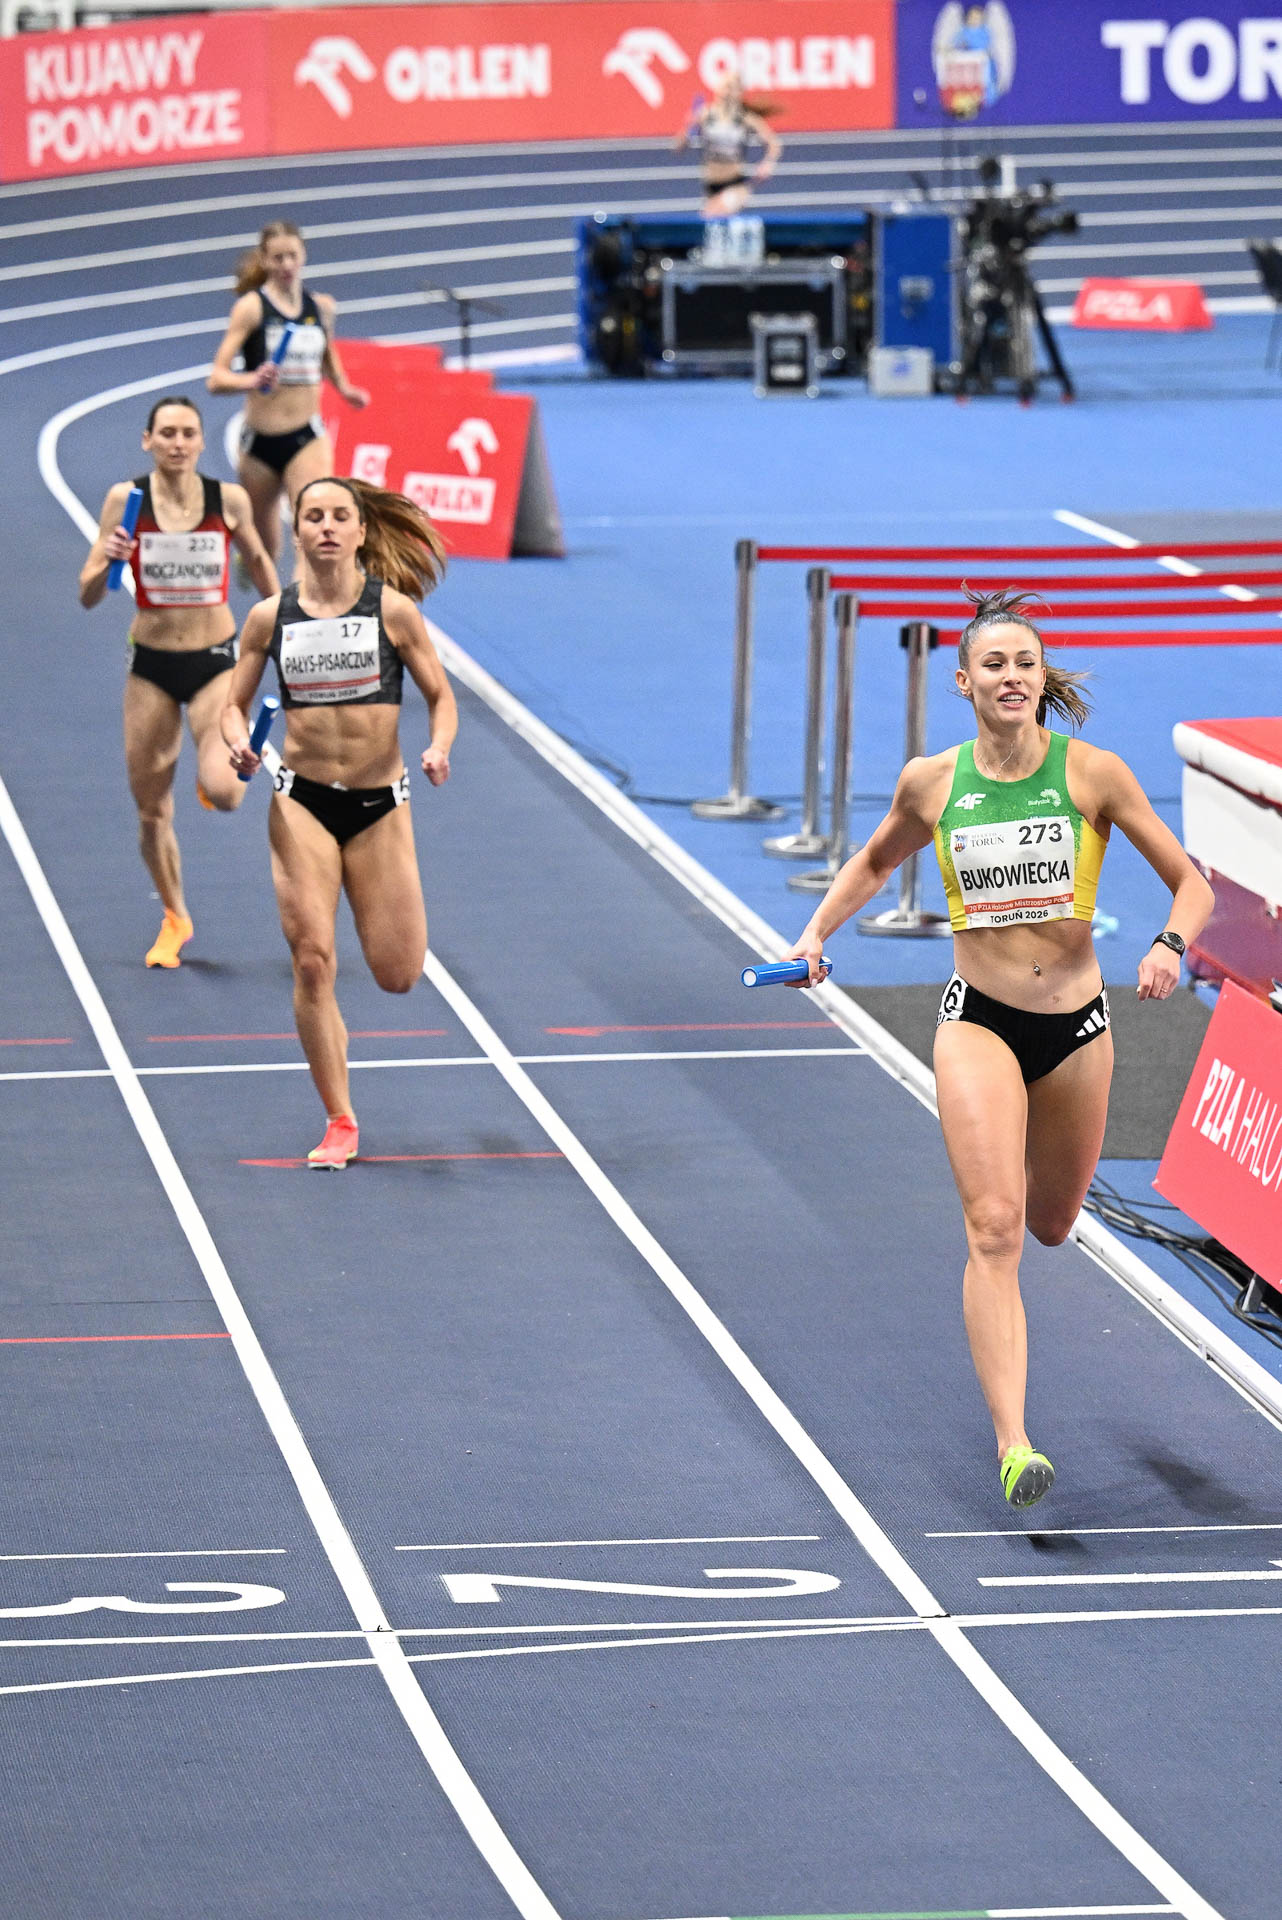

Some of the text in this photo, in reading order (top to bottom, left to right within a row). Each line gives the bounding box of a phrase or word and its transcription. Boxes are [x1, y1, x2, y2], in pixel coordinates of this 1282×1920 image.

[25, 29, 204, 103] KUJAWY
[385, 43, 551, 102] ORLEN
[698, 35, 875, 93] ORLEN
[1101, 17, 1282, 104] TOR
[28, 88, 243, 166] POMORZE
[341, 623, 362, 638] 17
[284, 650, 376, 674] PAŁYS-PISARCZUK
[954, 792, 987, 810] 4F
[1018, 822, 1063, 846] 273
[960, 859, 1070, 892] BUKOWIECKA
[977, 903, 991, 911] PZLA
[1014, 898, 1053, 909] Mistrzostwa
[990, 909, 1049, 924] TORUŃ 2026
[944, 979, 962, 1014] 6
[1191, 1058, 1282, 1193] PZLA HALO
[439, 1568, 842, 1603] 2
